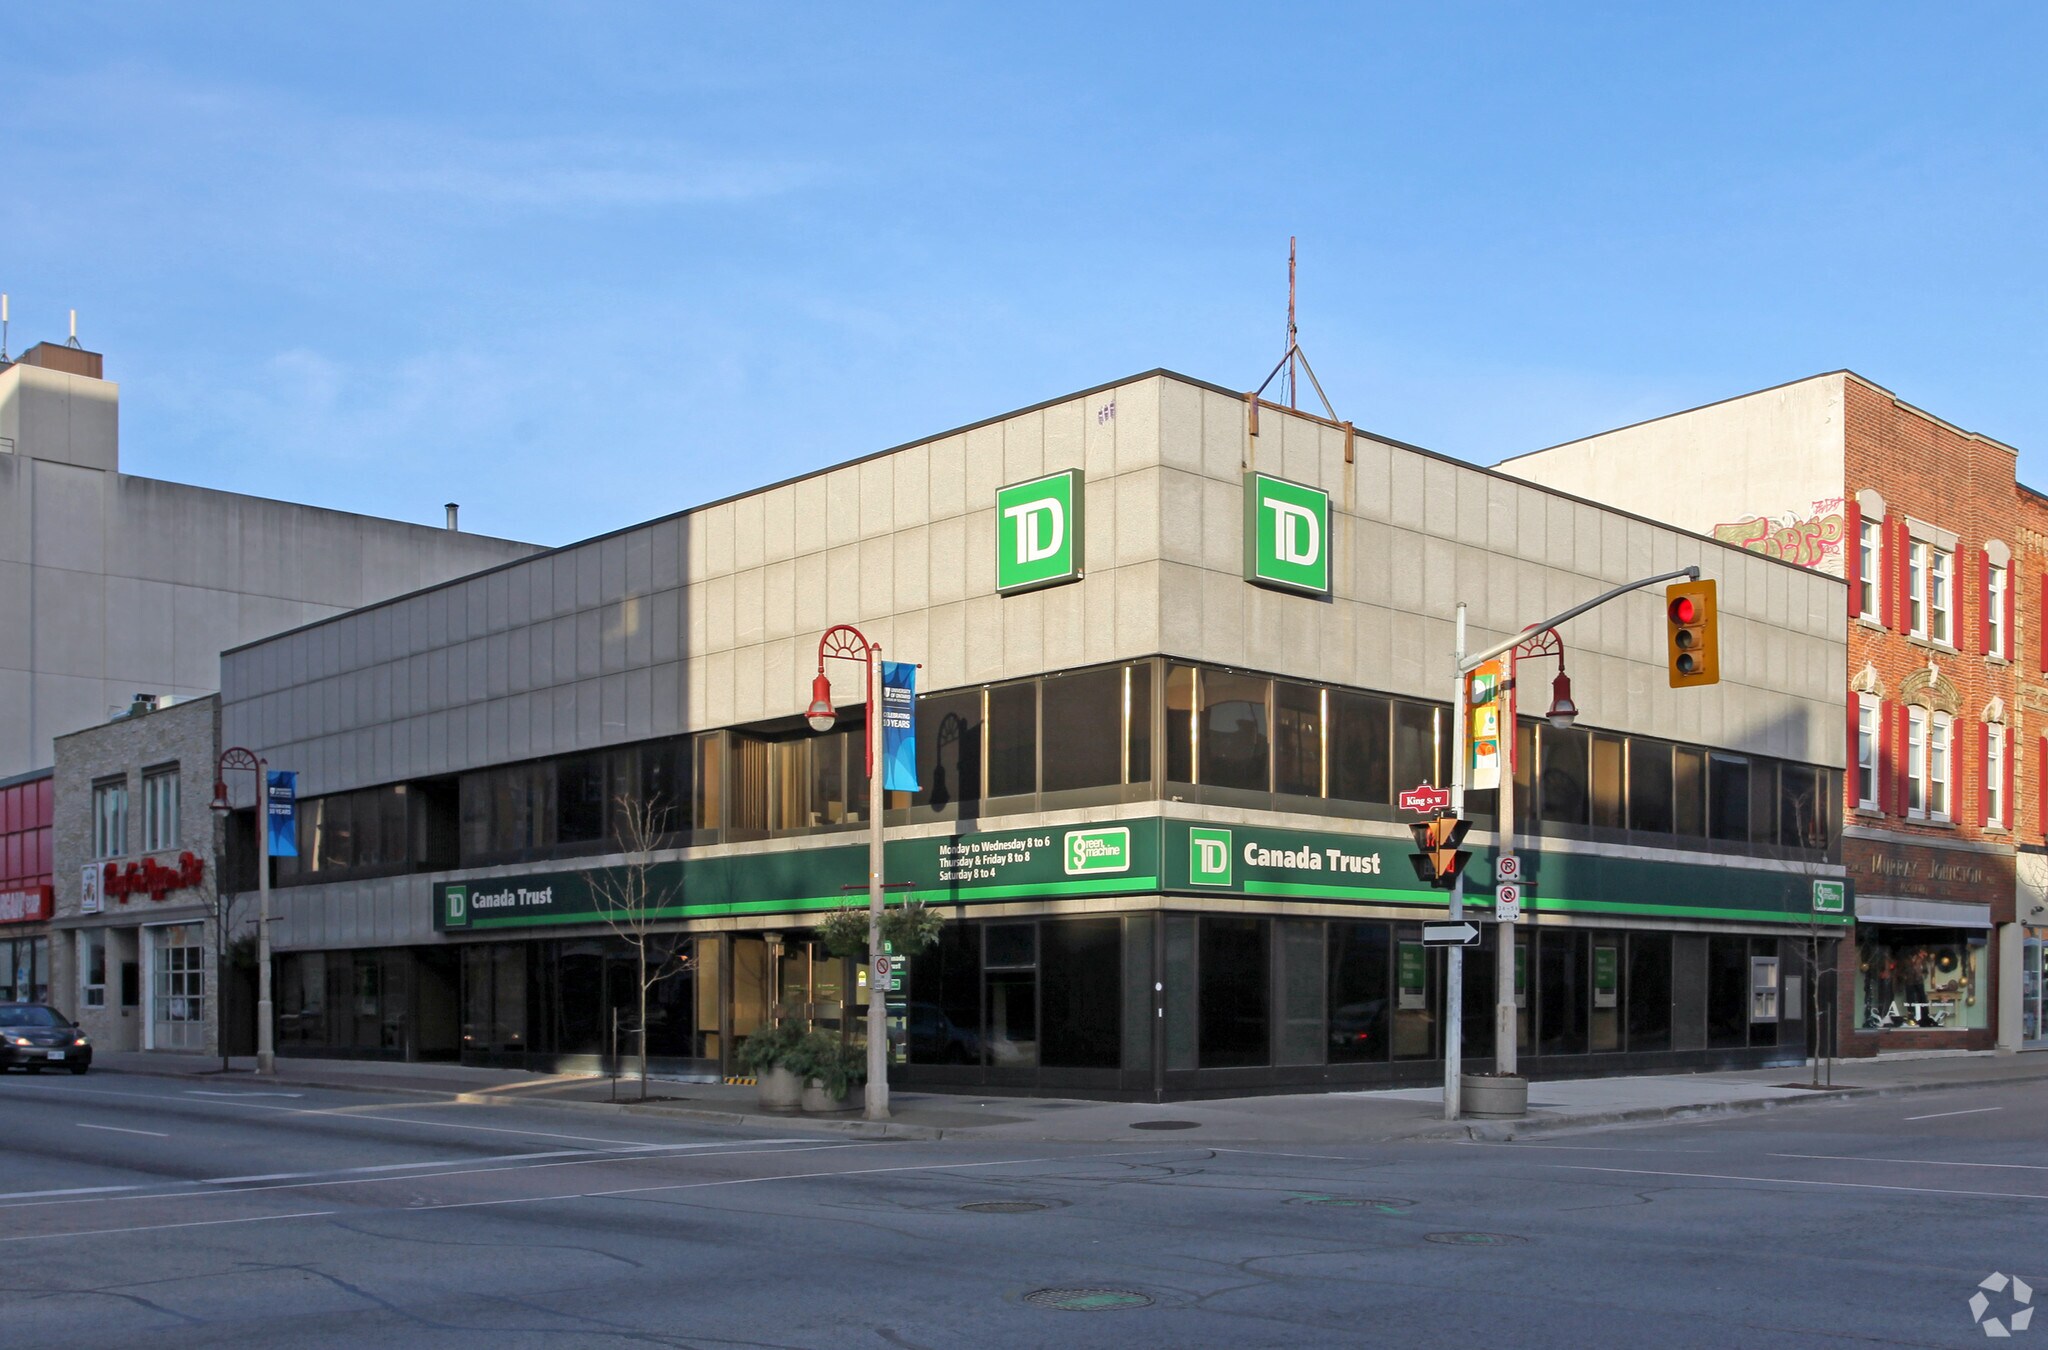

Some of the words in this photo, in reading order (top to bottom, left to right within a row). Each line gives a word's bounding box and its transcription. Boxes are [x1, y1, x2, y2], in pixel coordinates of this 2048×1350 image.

[1004, 497, 1064, 565] TD
[1264, 496, 1320, 566] TD
[891, 719, 910, 729] YEARS
[1406, 796, 1425, 807] King
[940, 843, 970, 855] Monday
[971, 844, 979, 852] to
[981, 839, 1026, 851] Wednesday
[1027, 838, 1033, 848] 8
[1034, 838, 1043, 847] to
[1044, 836, 1050, 846] 6
[1085, 844, 1120, 857] machine
[939, 856, 973, 868] Thursday
[975, 856, 981, 866] &
[982, 853, 1006, 866] Friday
[1007, 853, 1013, 863] 8
[1014, 853, 1023, 862] to
[1024, 852, 1030, 861] 8
[1194, 839, 1228, 874] TD
[1244, 842, 1322, 870] Canada
[1326, 849, 1380, 874] Trust
[940, 869, 972, 881] Saturday
[973, 869, 979, 878] 8
[980, 869, 989, 878] to
[989, 867, 995, 877] 4
[448, 893, 464, 917] TD
[472, 889, 515, 908] Canada
[517, 886, 552, 906] Trust
